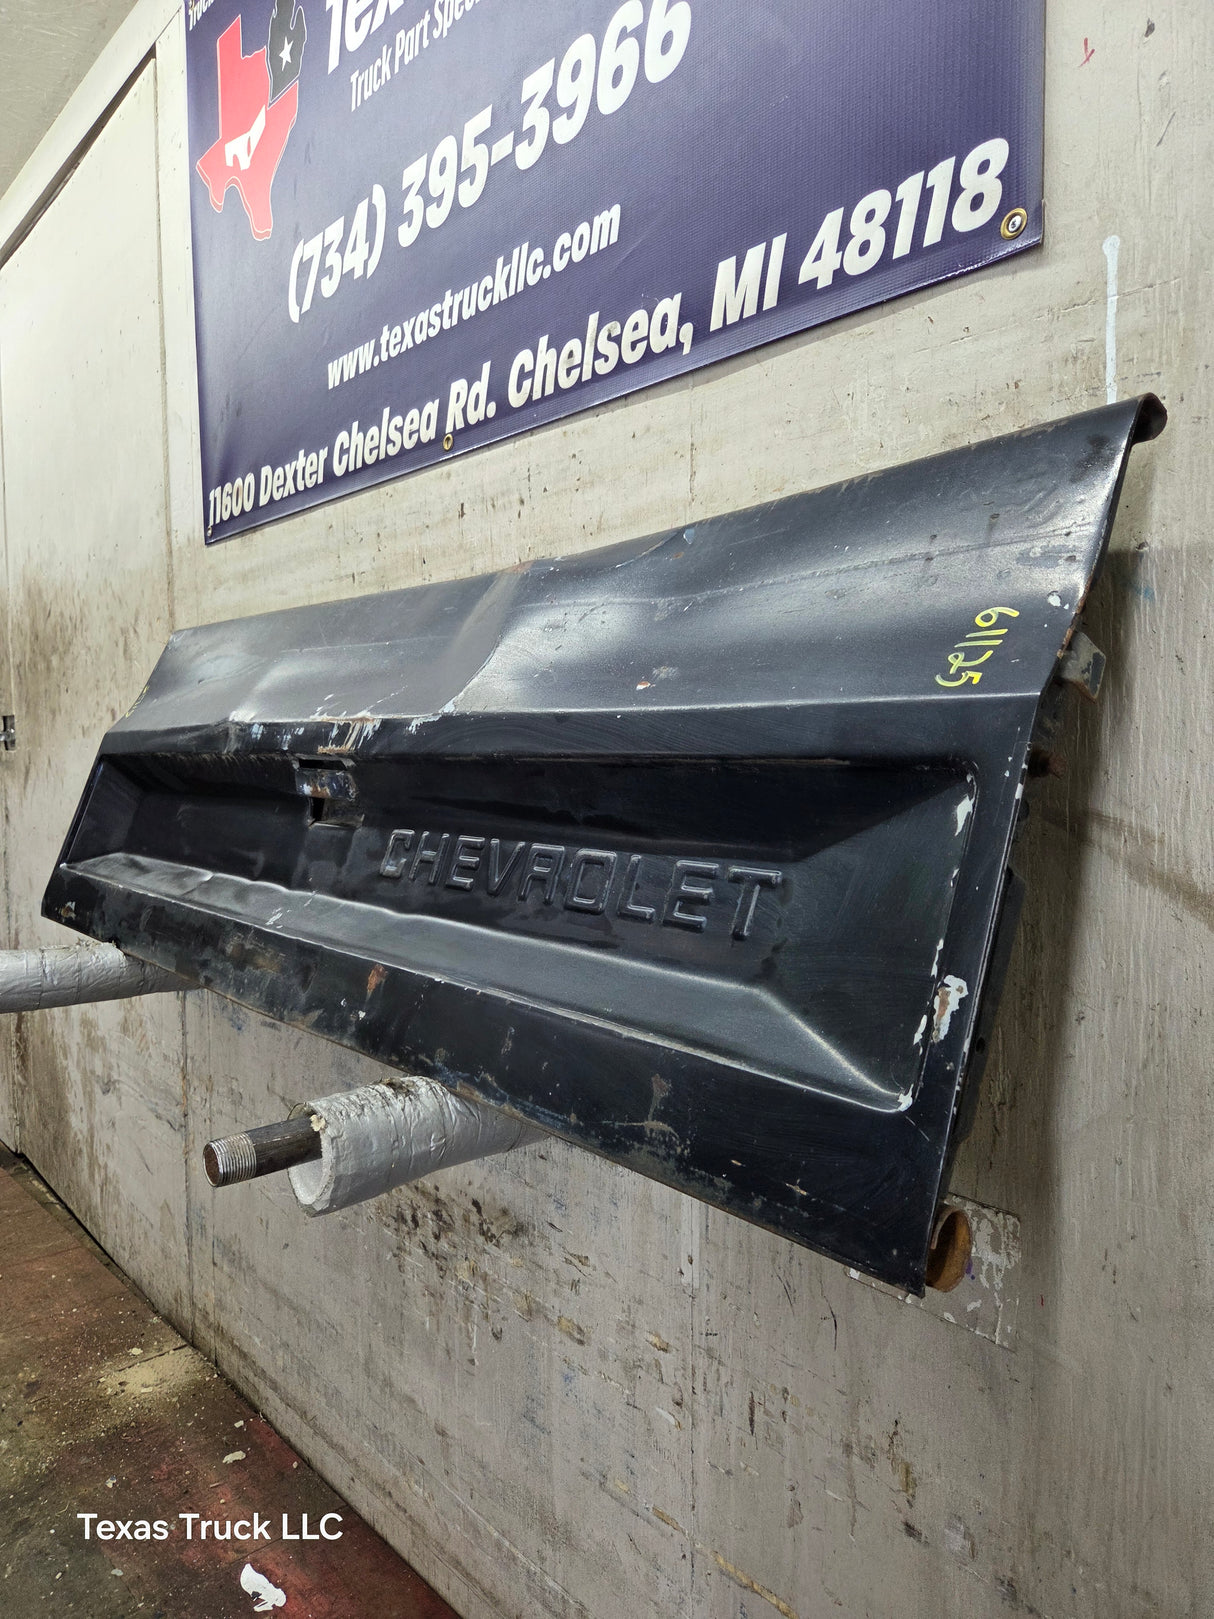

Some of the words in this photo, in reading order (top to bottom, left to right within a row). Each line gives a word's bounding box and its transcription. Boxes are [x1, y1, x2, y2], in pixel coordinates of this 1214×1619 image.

[350, 69, 392, 113] Truck
[394, 9, 431, 75] Part
[288, 183, 386, 323] (734)
[398, 0, 692, 248] 395-3966
[208, 472, 255, 528] 11600
[259, 446, 328, 508] Dexter
[332, 398, 440, 476] Chelsea
[444, 360, 496, 436] Rd.
[507, 292, 693, 411] Chelsea,
[709, 233, 787, 332] MI
[798, 137, 1010, 290] 48118
[327, 203, 621, 390] www.texastruckllc.com
[379, 828, 782, 941] CHEVROLET
